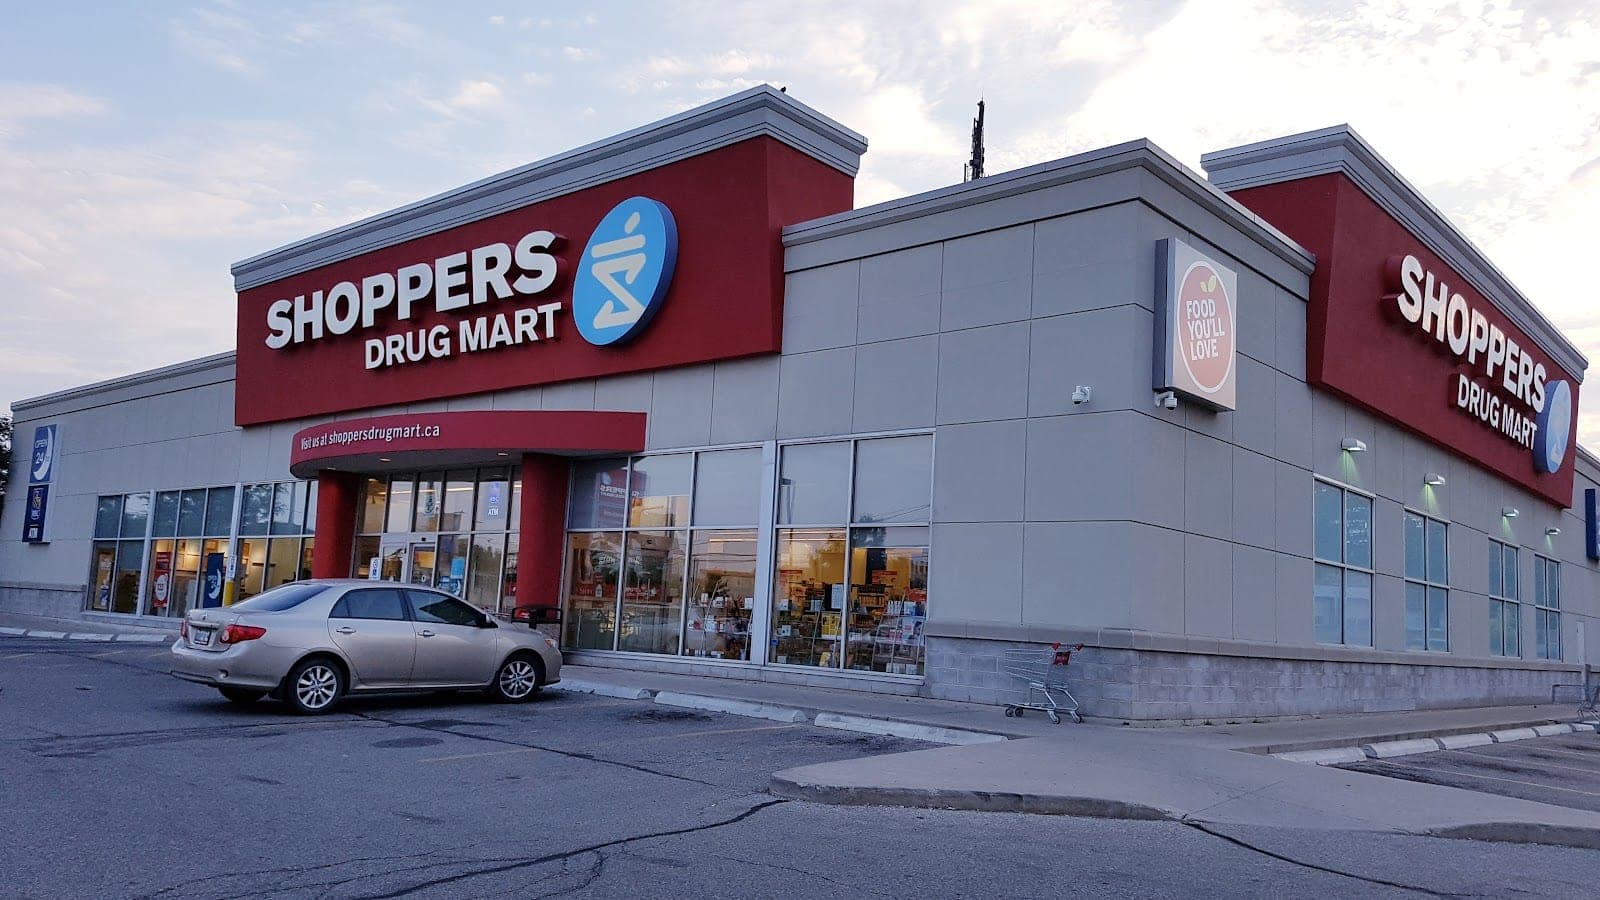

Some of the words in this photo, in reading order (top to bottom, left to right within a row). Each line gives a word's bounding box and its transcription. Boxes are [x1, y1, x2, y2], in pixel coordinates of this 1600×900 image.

[265, 230, 559, 350] SHOPPERS
[1186, 299, 1216, 319] FOOD
[365, 324, 451, 370] DRUG
[460, 302, 562, 353] MART
[1187, 318, 1226, 341] YOU'LL
[1190, 339, 1219, 361] LOVE
[1397, 254, 1546, 413] SHOPPERS
[301, 436, 312, 451] Visit
[312, 437, 320, 448] us
[320, 433, 328, 446] at
[329, 423, 440, 445] shoppersdrugmart.ca
[1457, 378, 1500, 429] DRUG
[1502, 405, 1537, 451] MART
